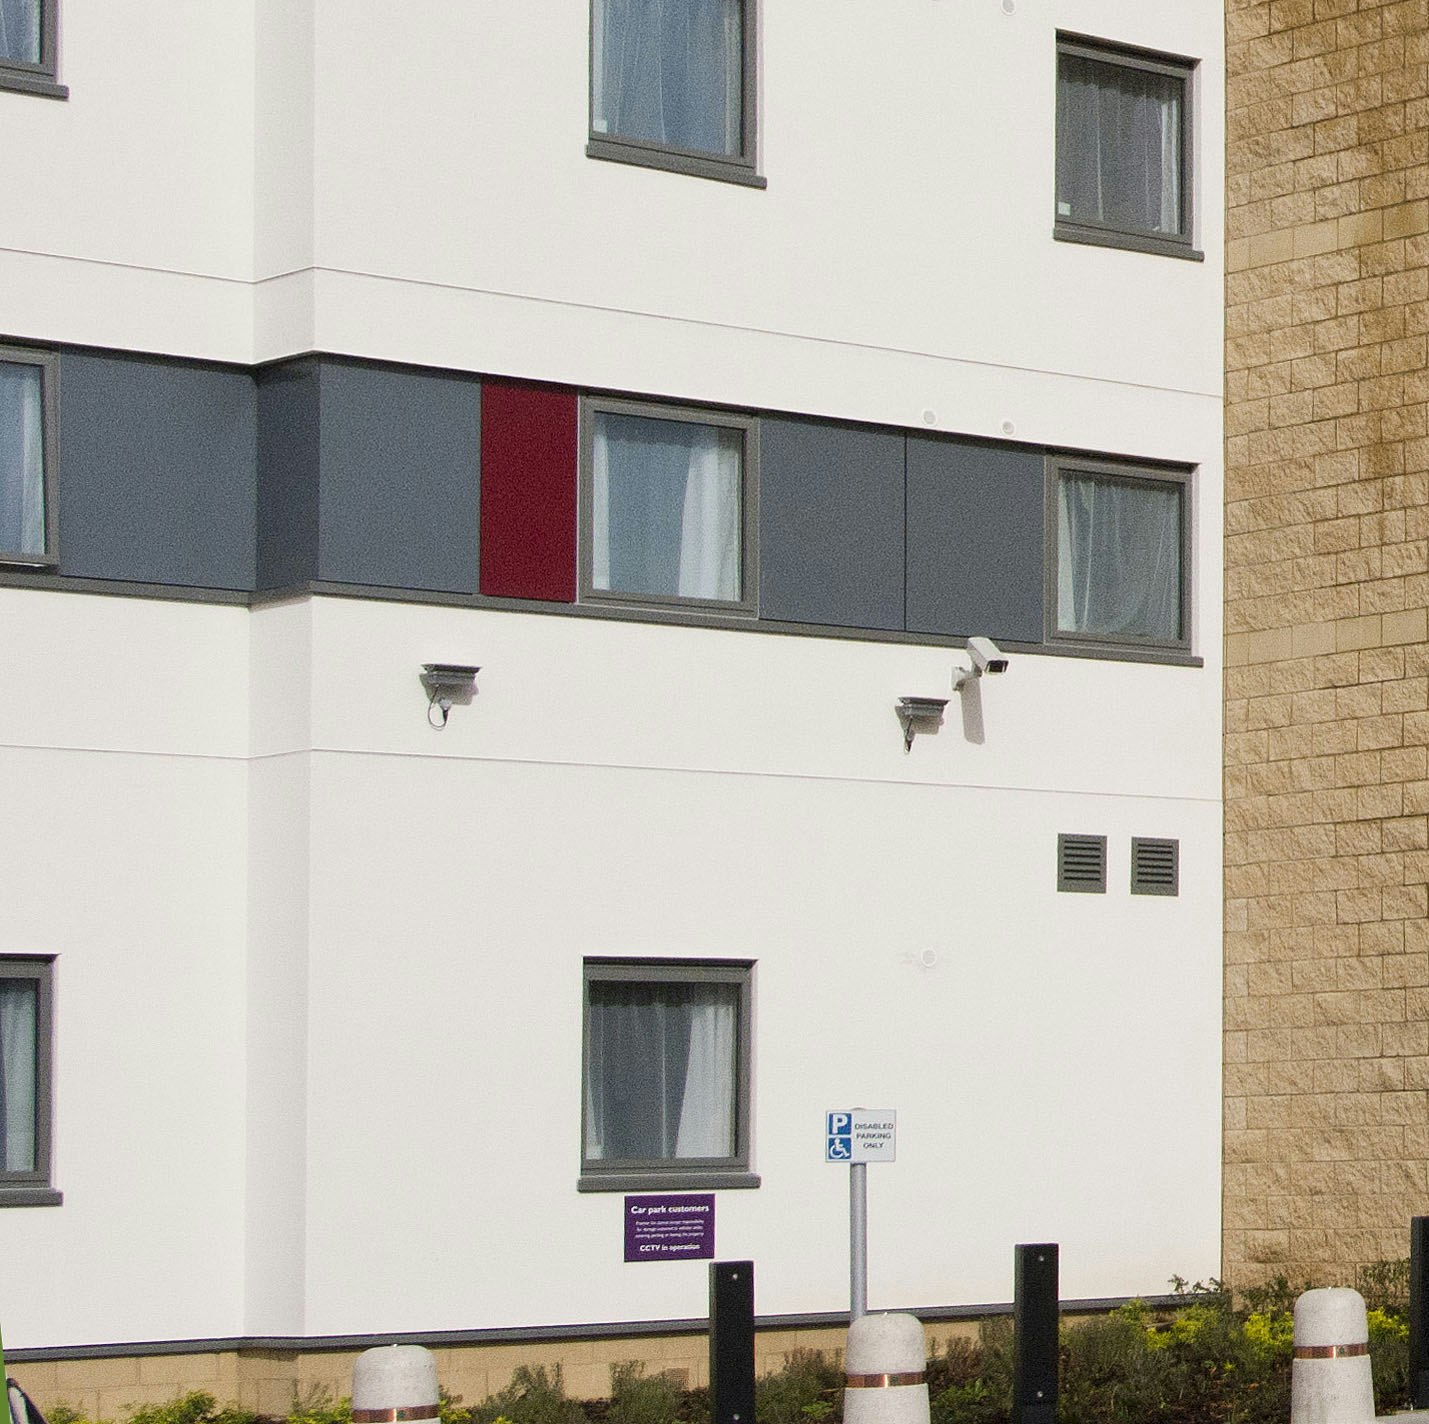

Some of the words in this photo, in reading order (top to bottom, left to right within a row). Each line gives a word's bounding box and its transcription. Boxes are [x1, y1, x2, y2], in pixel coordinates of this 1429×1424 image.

[832, 1114, 848, 1134] P
[856, 1132, 892, 1140] PARKING
[631, 1206, 646, 1215] Car
[648, 1205, 666, 1216] park
[668, 1205, 709, 1213] customers
[640, 1244, 660, 1252] CCTV
[669, 1243, 700, 1252] operation
